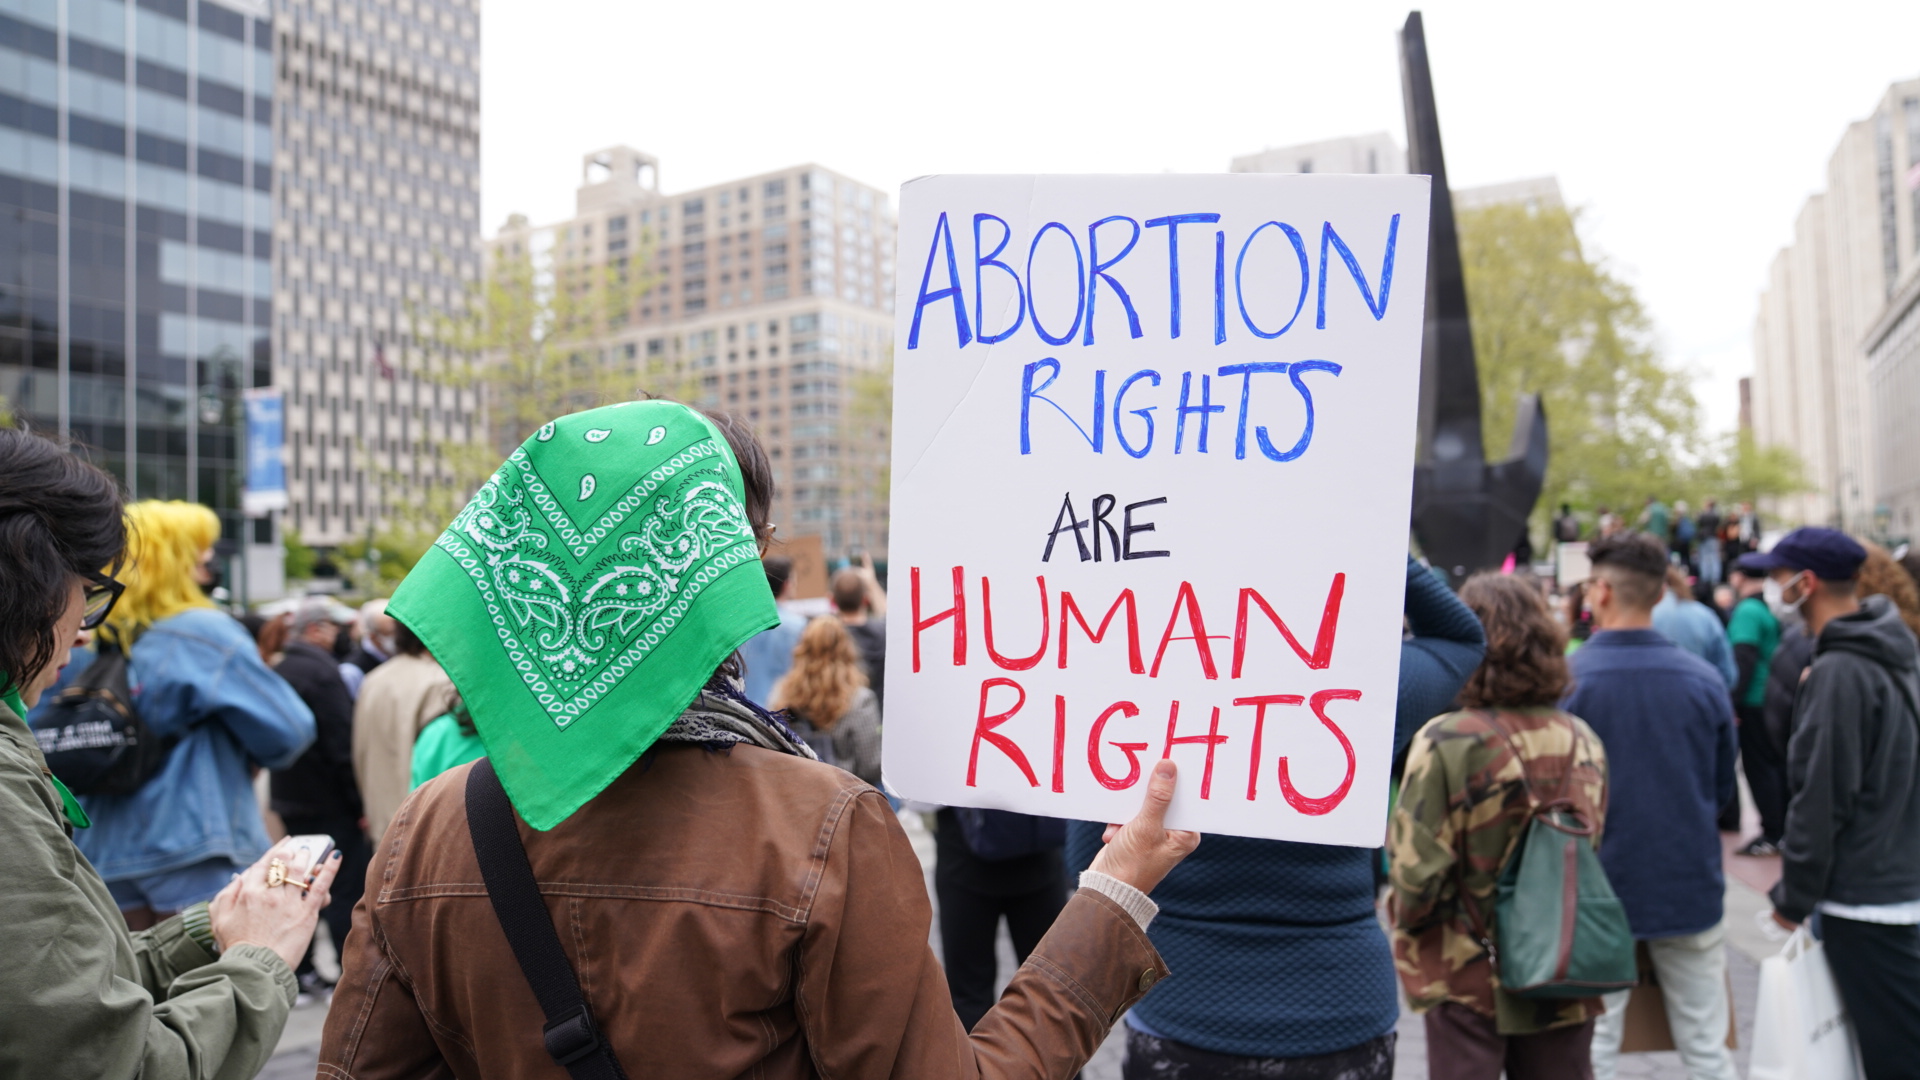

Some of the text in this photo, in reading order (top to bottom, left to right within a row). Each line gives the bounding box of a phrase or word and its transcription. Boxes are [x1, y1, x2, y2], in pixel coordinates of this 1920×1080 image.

[907, 211, 1400, 350] ABORTION
[1020, 357, 1343, 462] RIGHTS
[1041, 491, 1171, 563] ARE
[911, 565, 1346, 680] HUMAN
[966, 677, 1363, 817] RIGHTS
